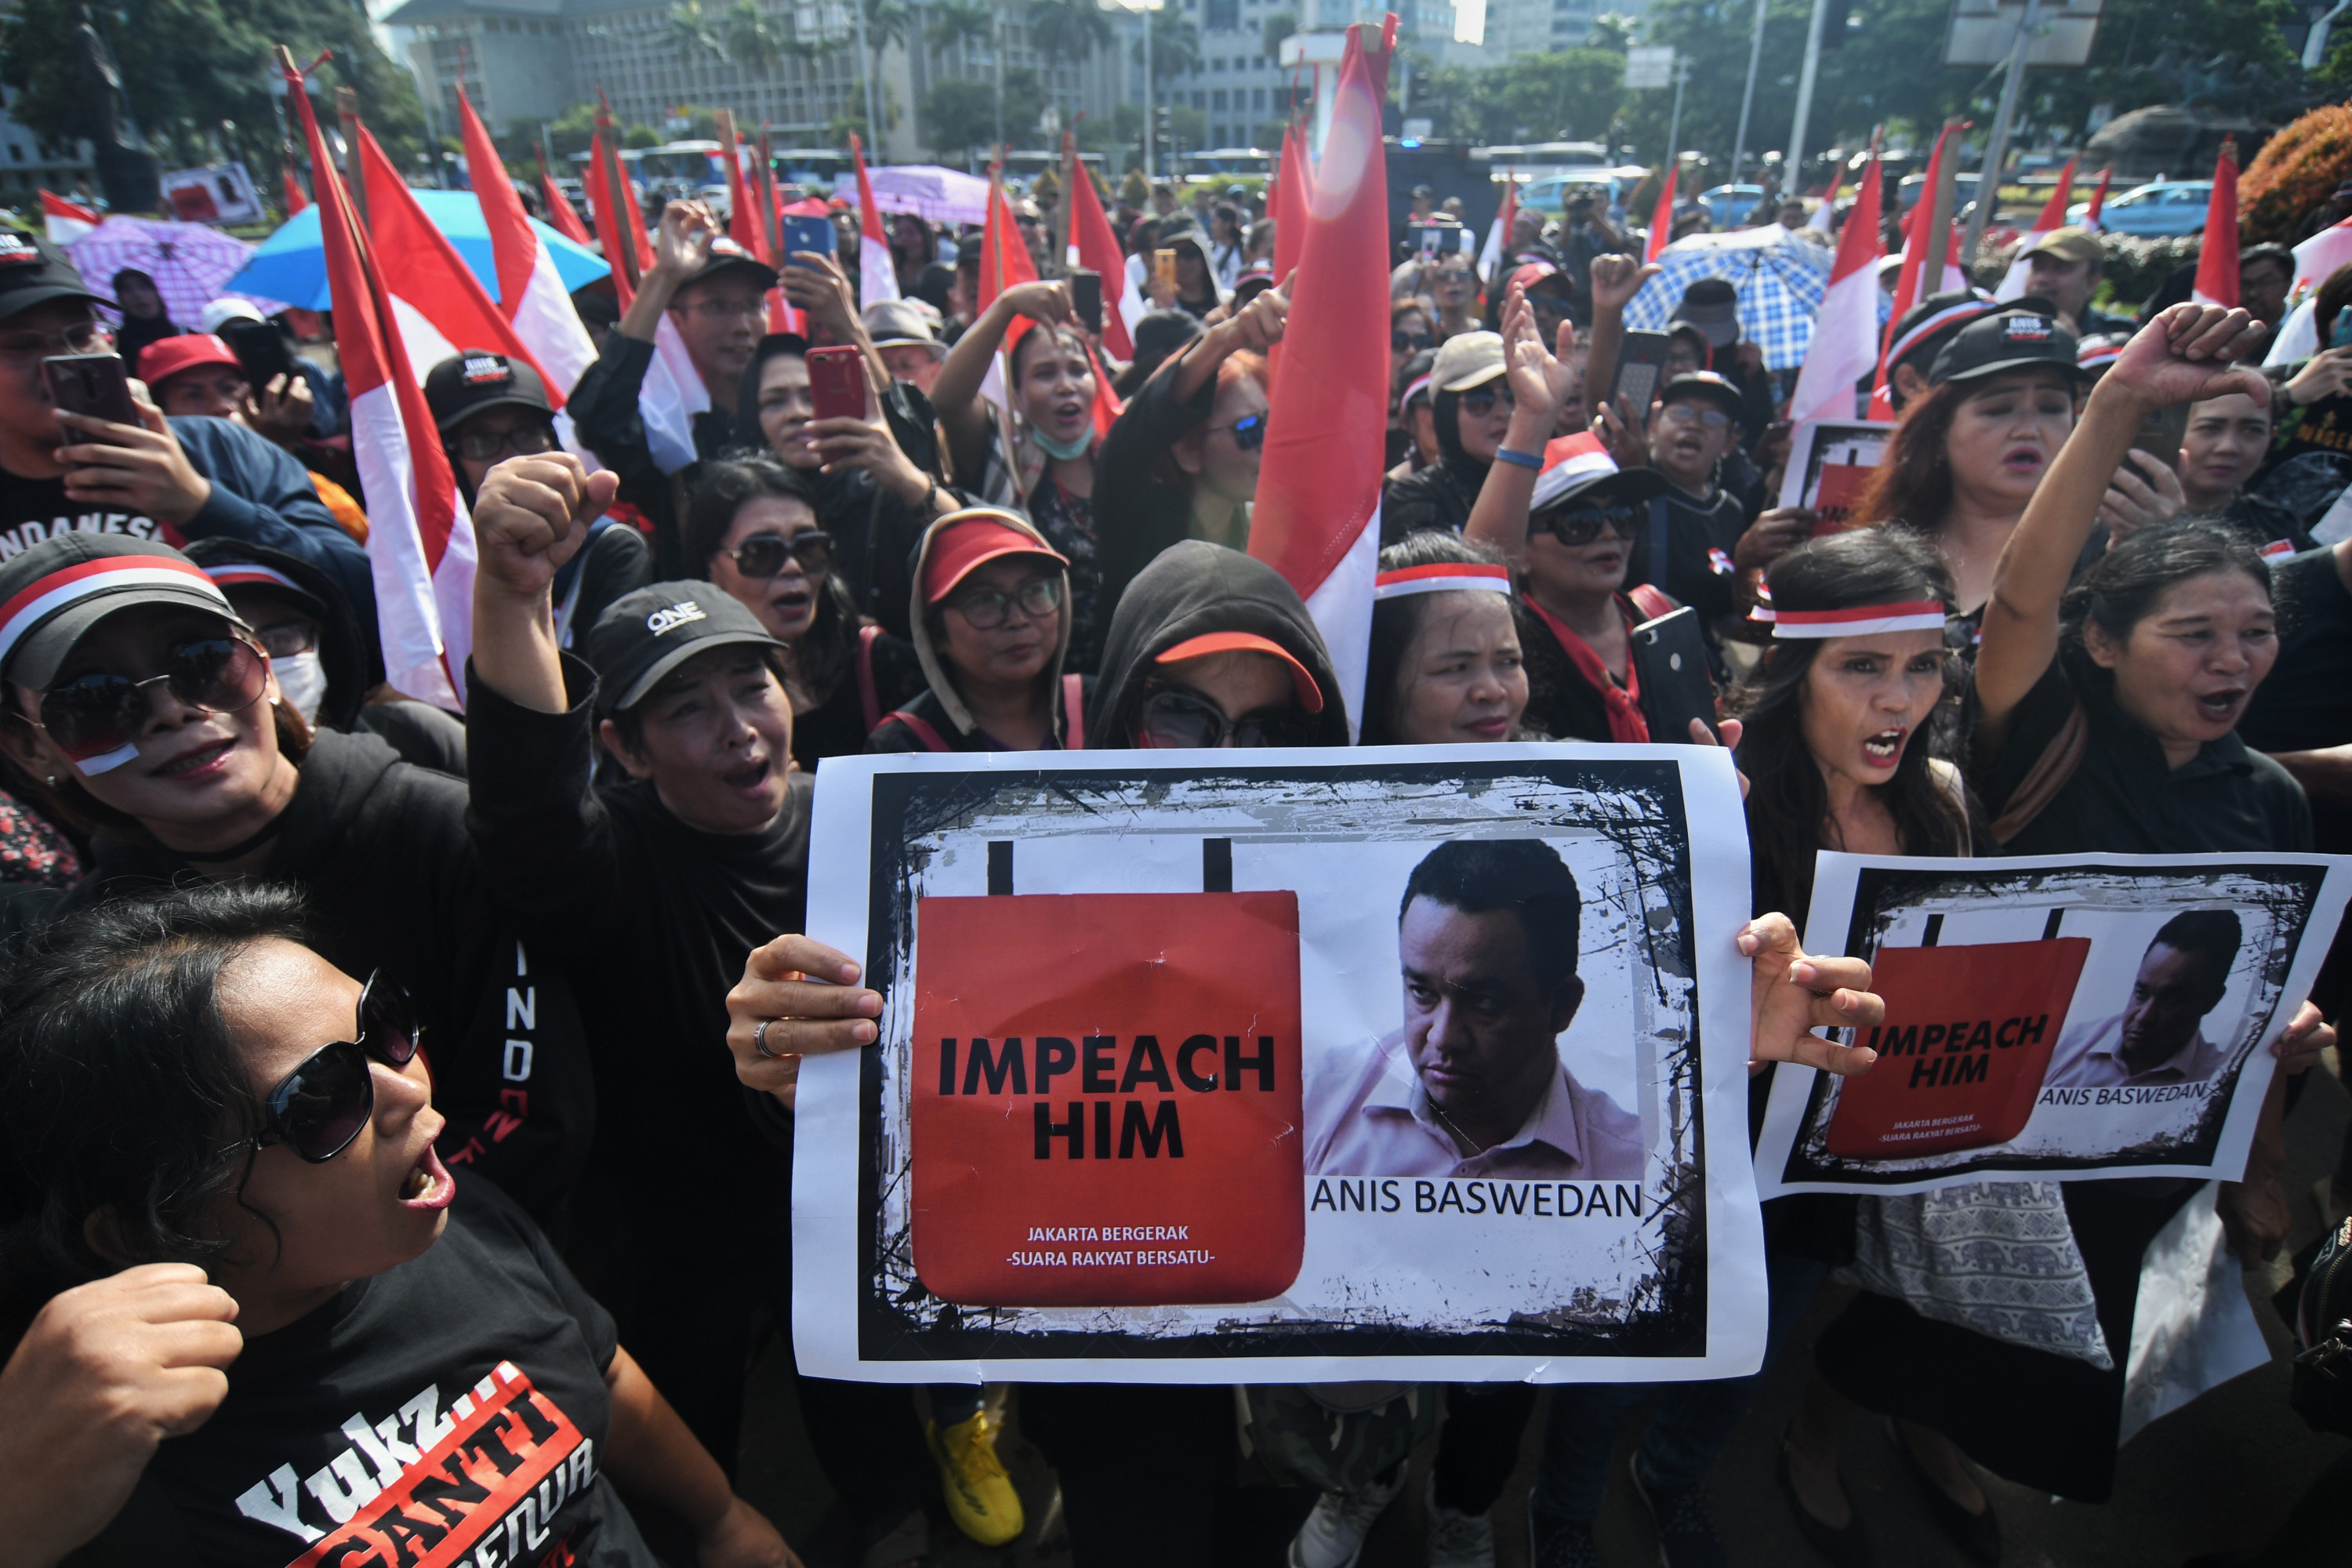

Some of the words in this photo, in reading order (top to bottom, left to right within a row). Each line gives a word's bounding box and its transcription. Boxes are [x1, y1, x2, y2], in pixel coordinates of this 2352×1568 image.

[647, 601, 704, 632] ONE
[1867, 1014, 2049, 1058] IMPEACH
[938, 1033, 1276, 1096] IMPEACH
[1907, 1053, 1990, 1089] HIM
[2038, 1088, 2092, 1105] ANIS
[2095, 1082, 2207, 1105] BASWEDAN
[1033, 1100, 1185, 1160] HIM
[1878, 1132, 1911, 1142] -SUARA
[1912, 1129, 1945, 1140] RAKYAT
[1893, 1120, 1930, 1130] JAKARTA
[1931, 1113, 1975, 1127] BERGERAK
[1310, 1178, 1402, 1213] ANIS
[1415, 1180, 1642, 1217] BASWEDAN
[1027, 1226, 1098, 1242] JAKARTA
[1102, 1225, 1189, 1241] BERGERAK
[1006, 1250, 1068, 1266] -SUARA
[1071, 1250, 1134, 1266] RAKYAT
[1137, 1250, 1215, 1265] BERSATU-
